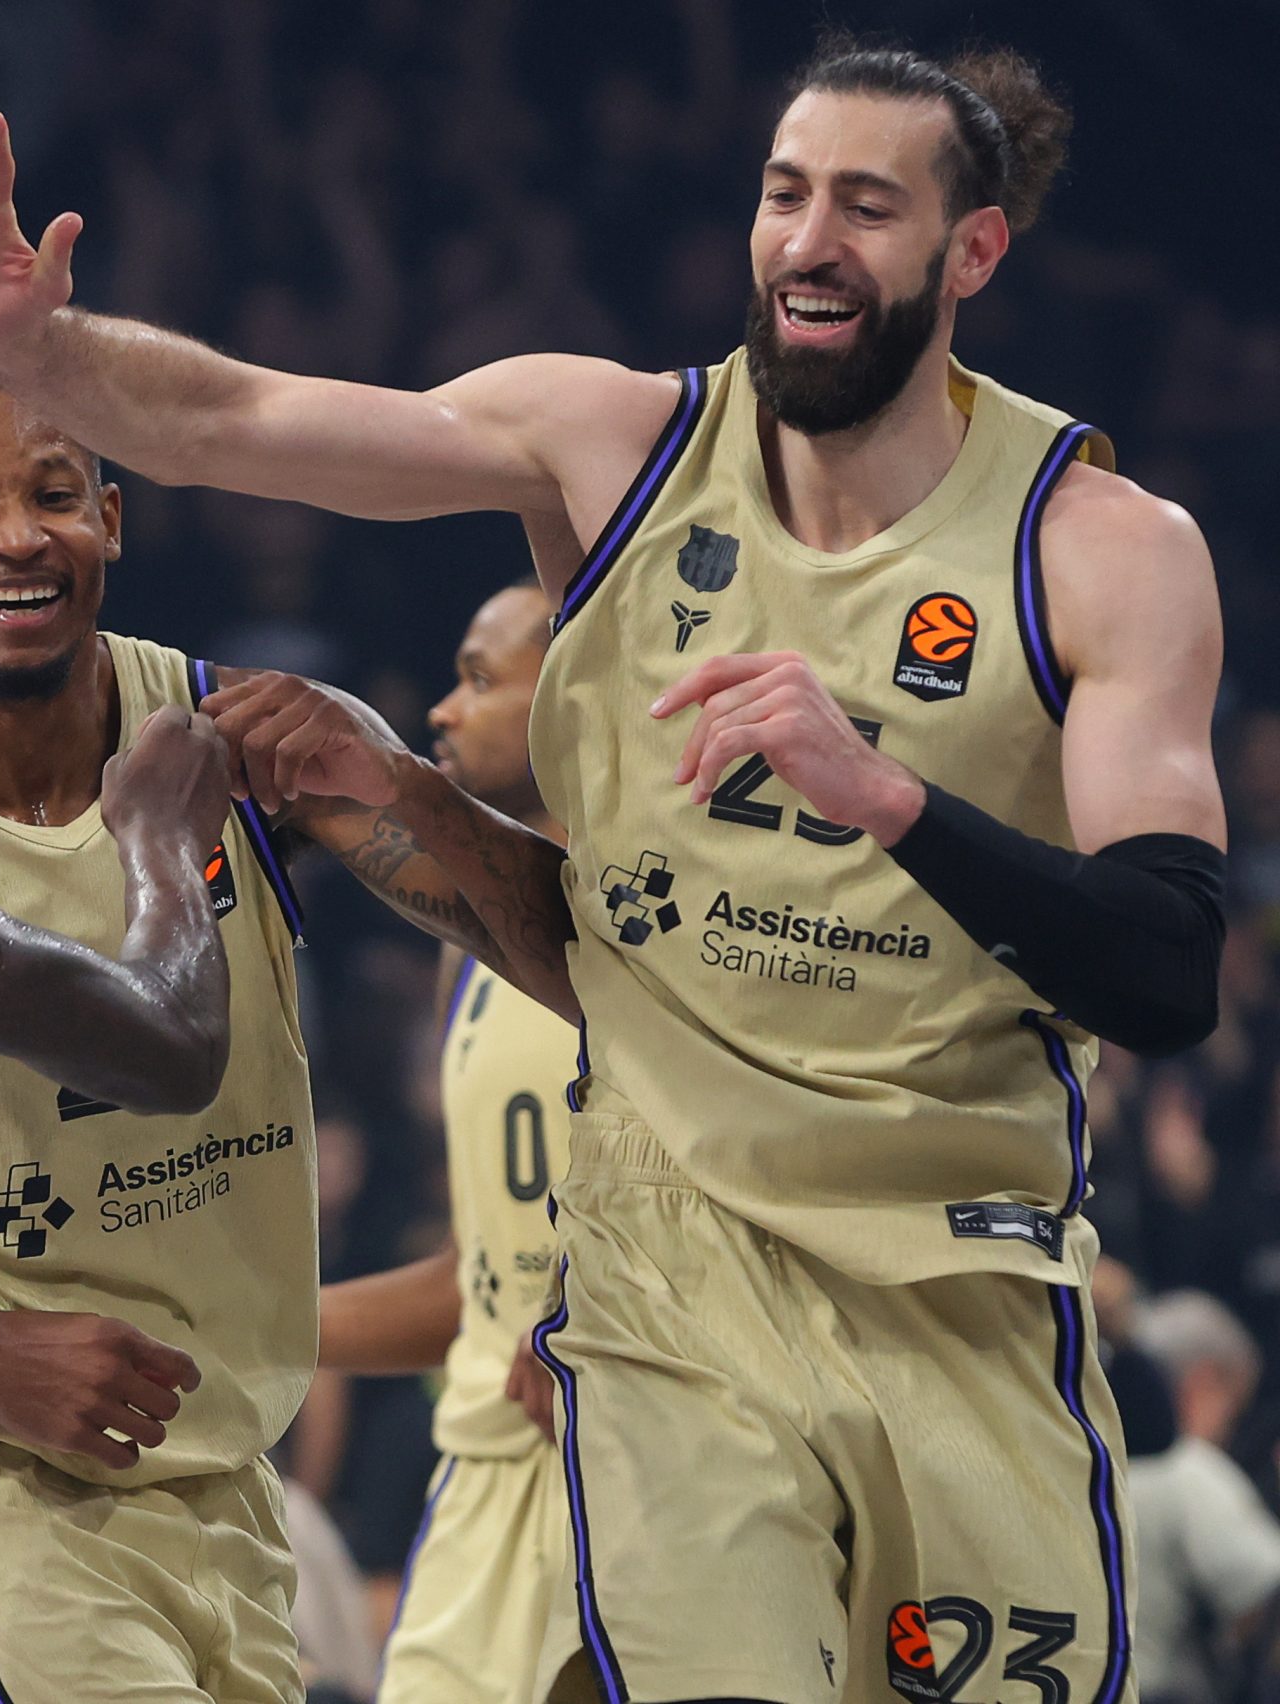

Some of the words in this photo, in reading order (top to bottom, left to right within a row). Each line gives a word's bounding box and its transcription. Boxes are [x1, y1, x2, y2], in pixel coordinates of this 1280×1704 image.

[897, 671, 923, 685] abu
[923, 674, 963, 692] dhabi
[212, 894, 233, 910] abi
[704, 890, 932, 960] Assistència
[699, 930, 858, 993] Sanitària
[96, 1123, 295, 1198] Assistència
[505, 1090, 549, 1202] 0
[99, 1167, 231, 1233] Sanitària
[924, 1595, 1078, 1704] 23
